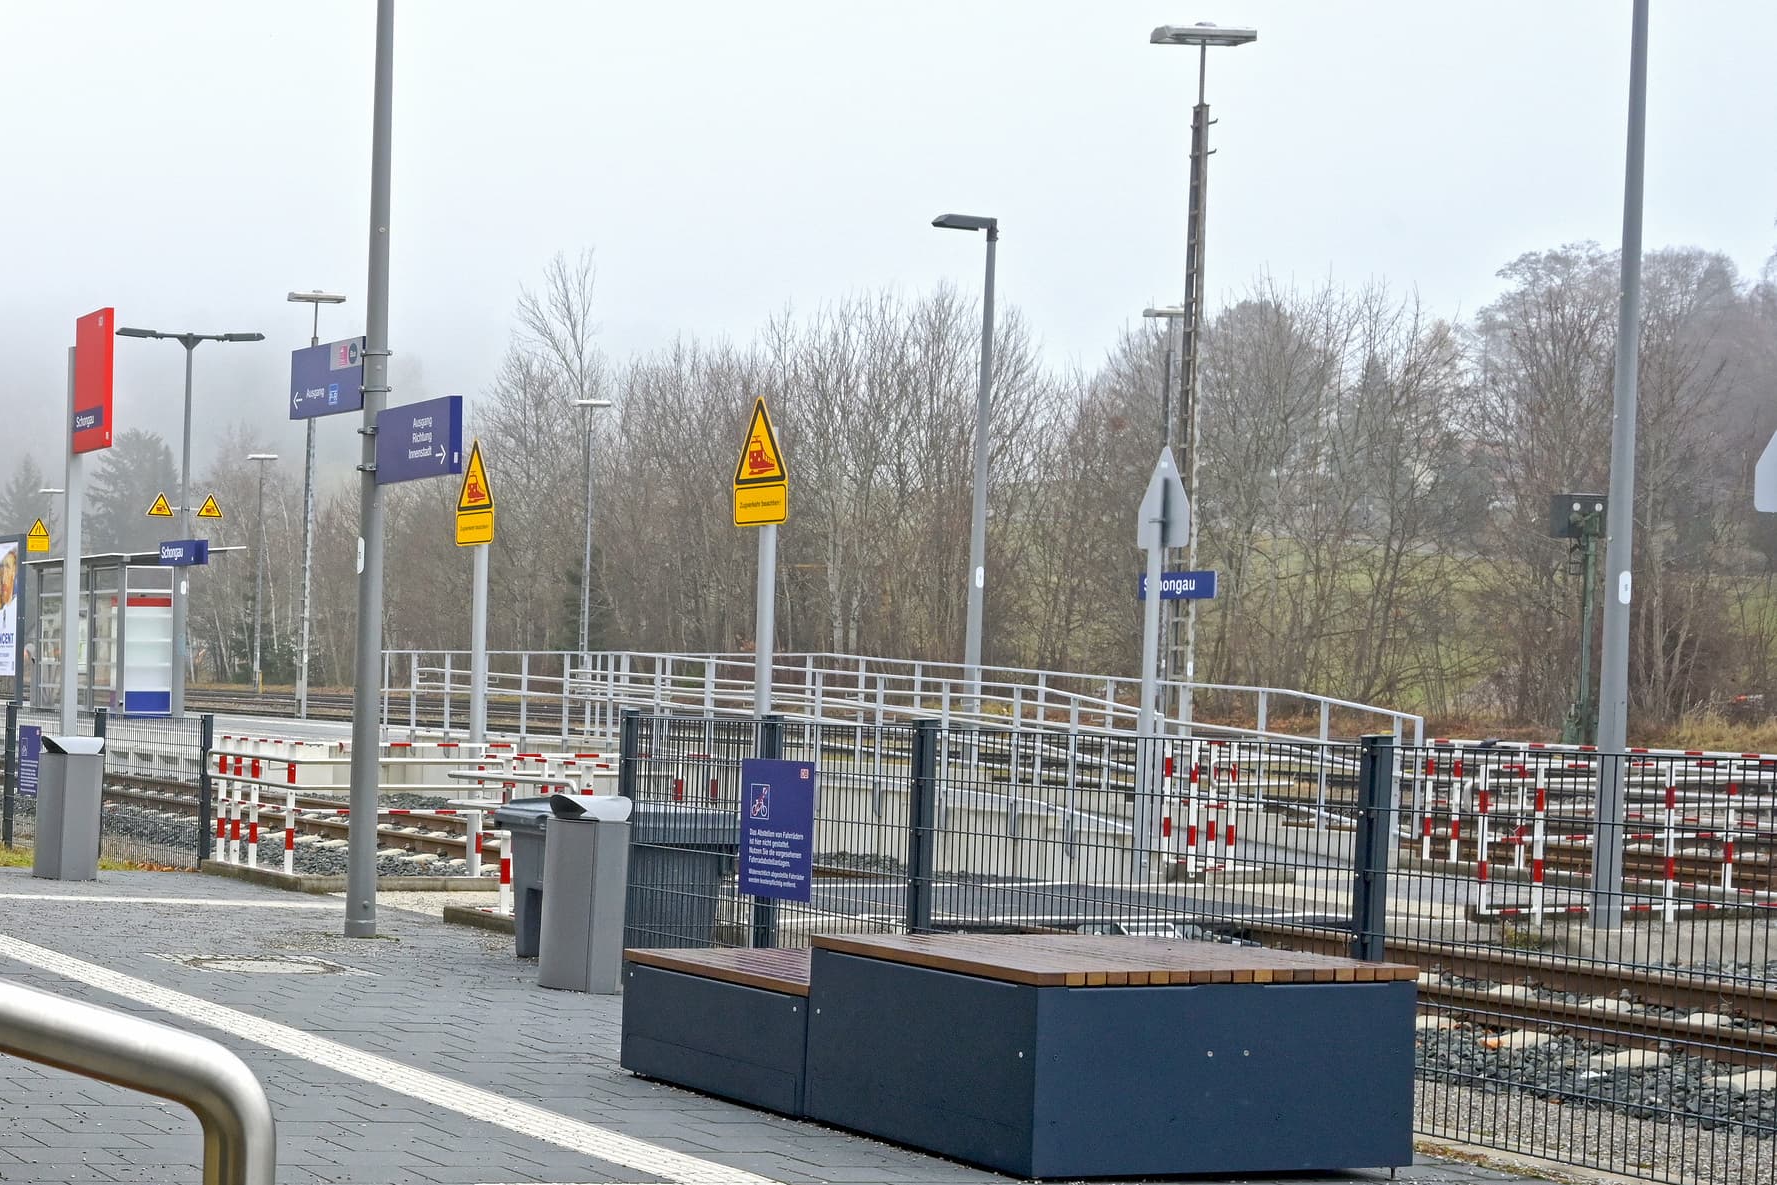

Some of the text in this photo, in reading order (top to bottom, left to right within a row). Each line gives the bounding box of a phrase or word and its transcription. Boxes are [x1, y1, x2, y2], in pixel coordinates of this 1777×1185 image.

[306, 388, 325, 399] Ausgang
[76, 415, 94, 428] Schongau
[413, 417, 432, 428] Ausgang
[412, 432, 432, 443] Richtung
[408, 446, 432, 459] Innenstadt
[161, 546, 184, 560] Schongau
